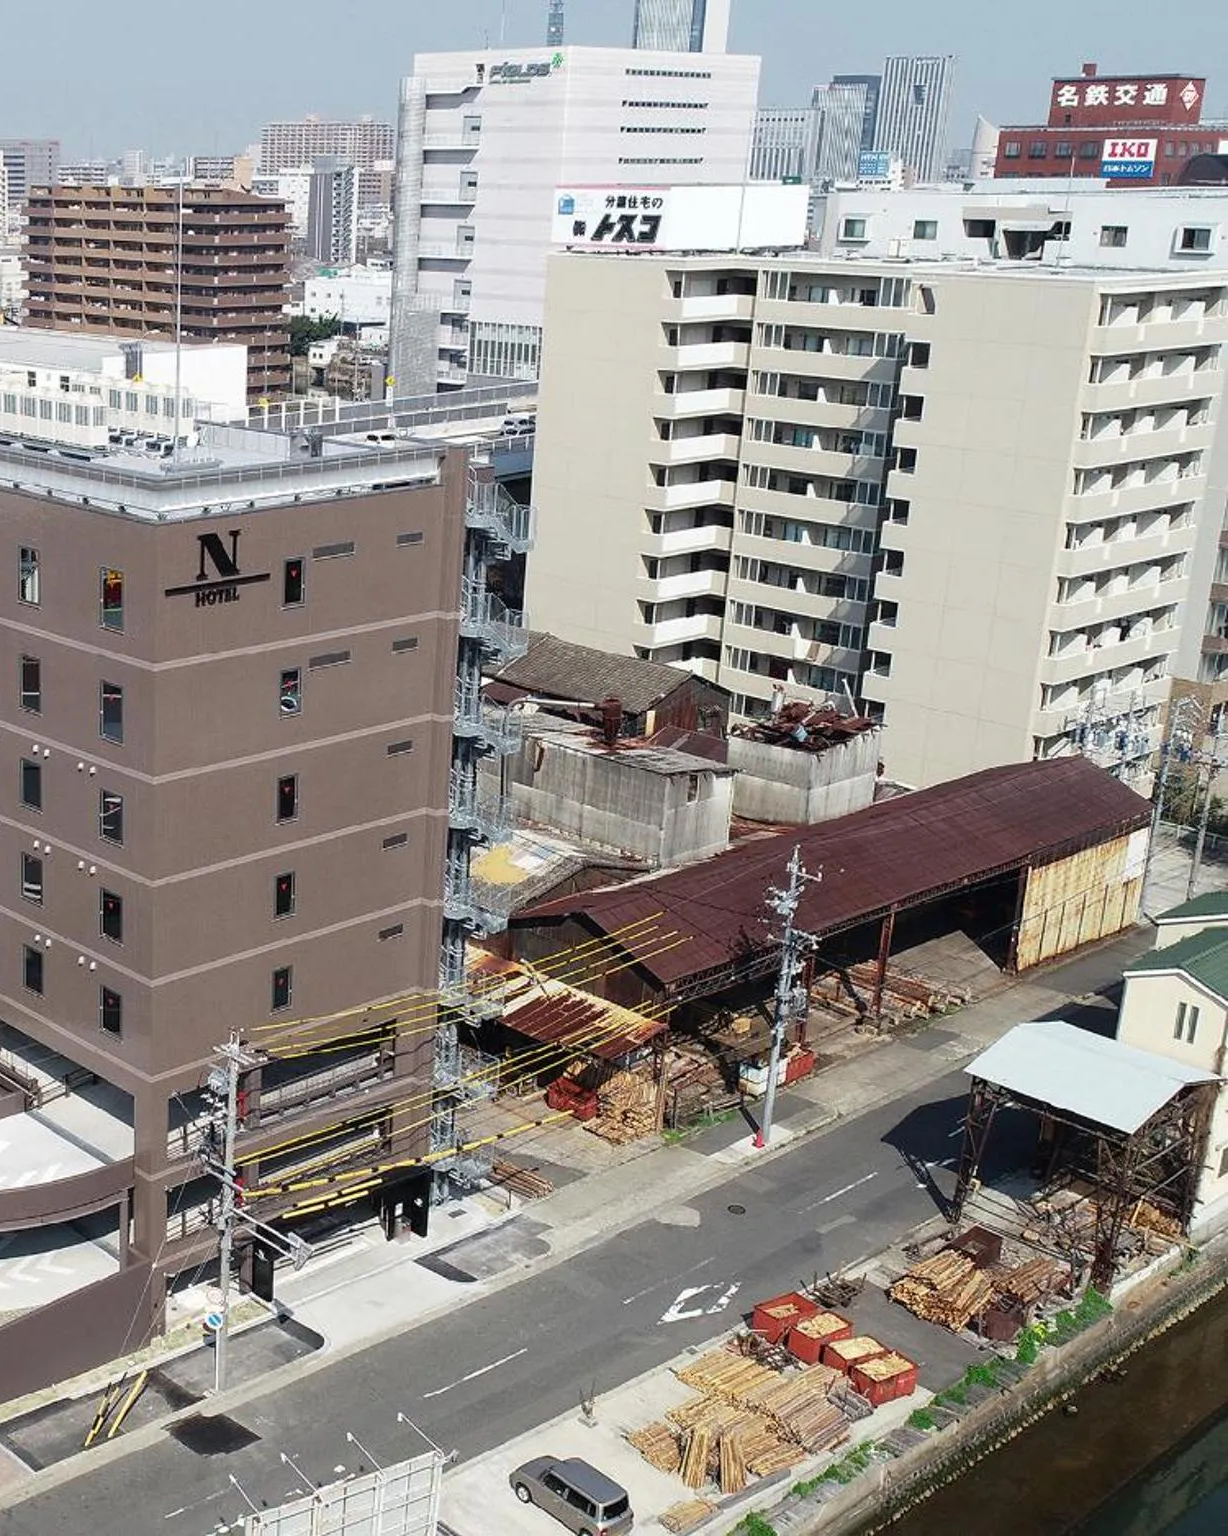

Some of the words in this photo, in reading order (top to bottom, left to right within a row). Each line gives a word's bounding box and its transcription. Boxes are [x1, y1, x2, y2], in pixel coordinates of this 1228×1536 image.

[1057, 83, 1168, 107] 名鉄交通
[1108, 141, 1151, 158] IKO
[197, 529, 241, 581] N
[195, 587, 240, 608] HOTEL
